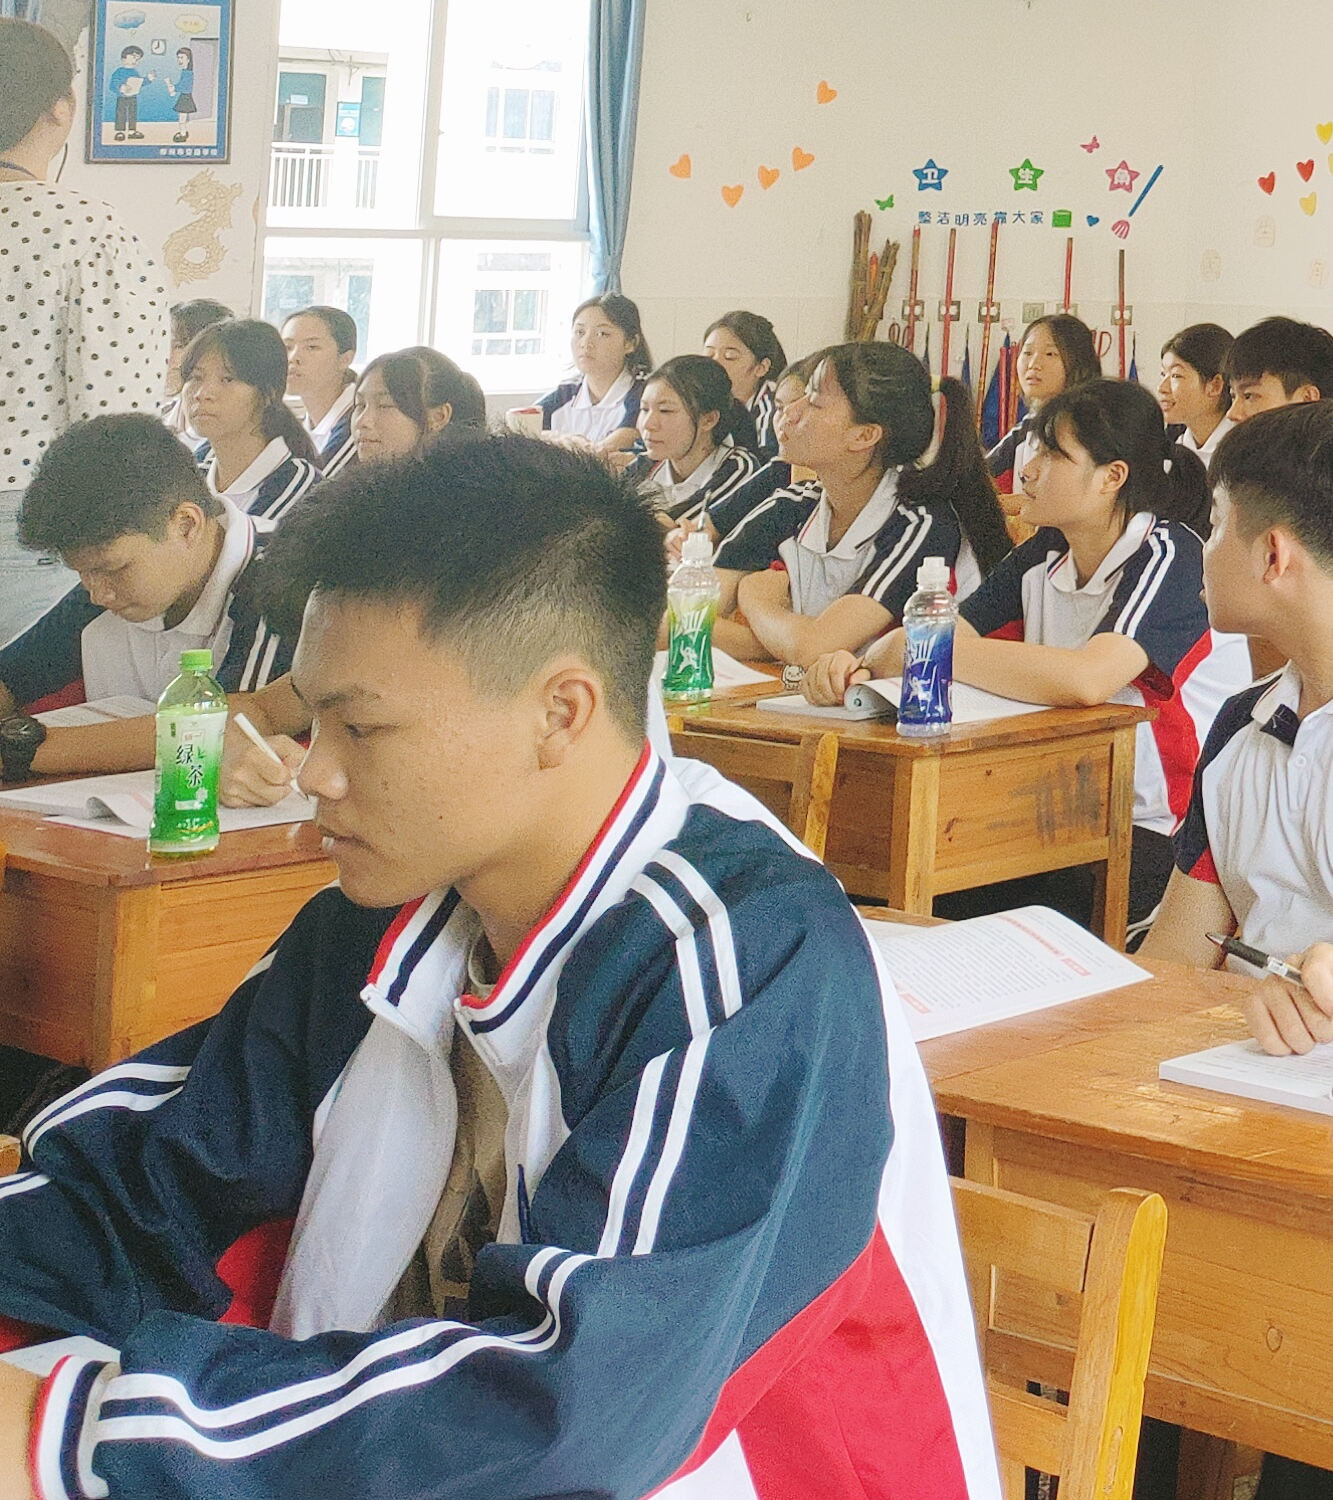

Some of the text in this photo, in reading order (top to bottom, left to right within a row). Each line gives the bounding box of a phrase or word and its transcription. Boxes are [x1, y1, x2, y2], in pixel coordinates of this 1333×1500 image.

[918, 211, 1044, 227] 整洁明亮靠大家
[176, 744, 203, 787] 绿茶
